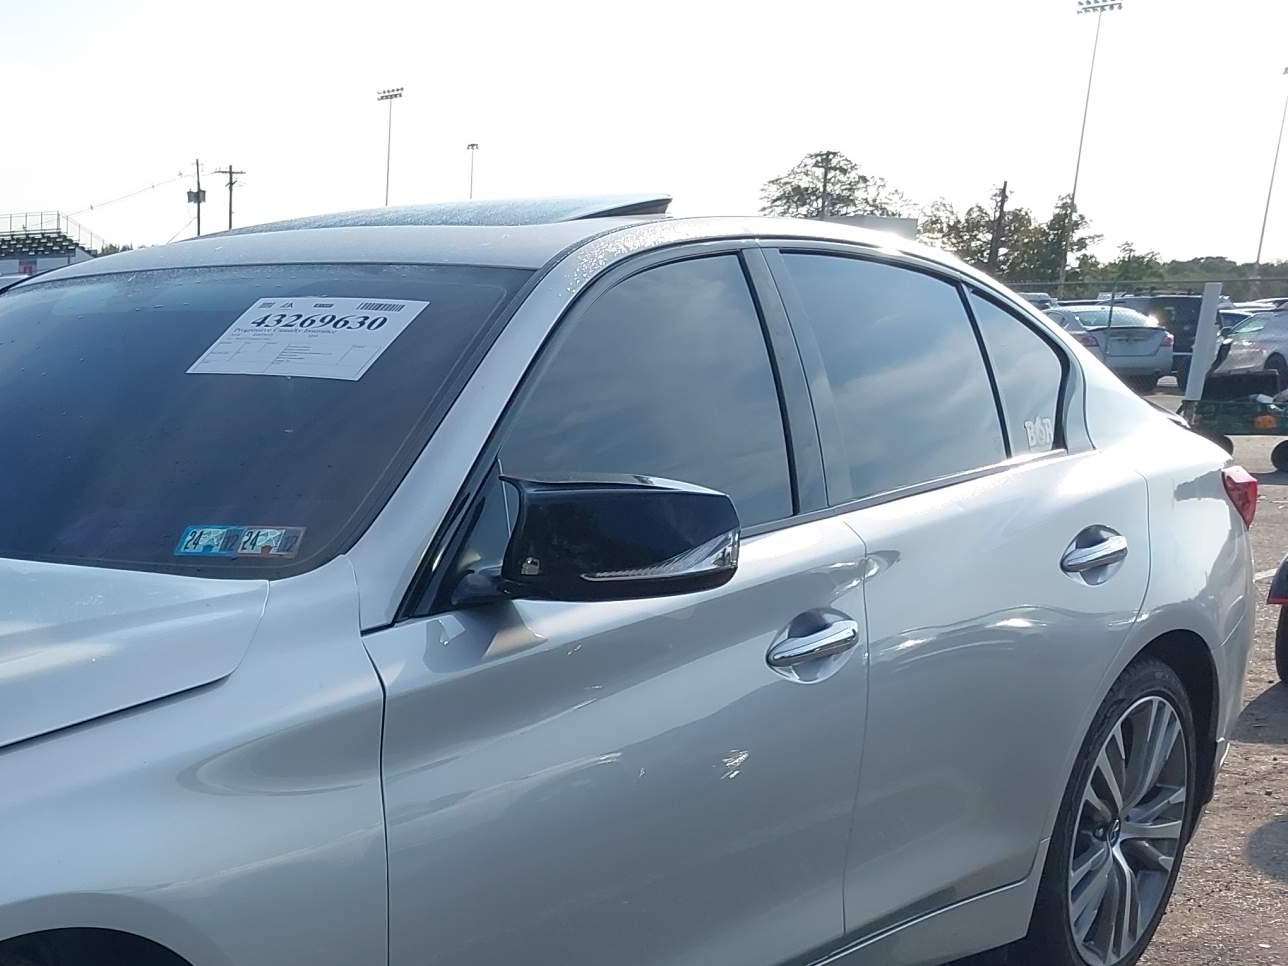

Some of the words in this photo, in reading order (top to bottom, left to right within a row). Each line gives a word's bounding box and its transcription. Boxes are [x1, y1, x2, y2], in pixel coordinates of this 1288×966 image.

[251, 313, 388, 331] 43269630
[184, 530, 204, 550] 24
[242, 530, 261, 551] 24
